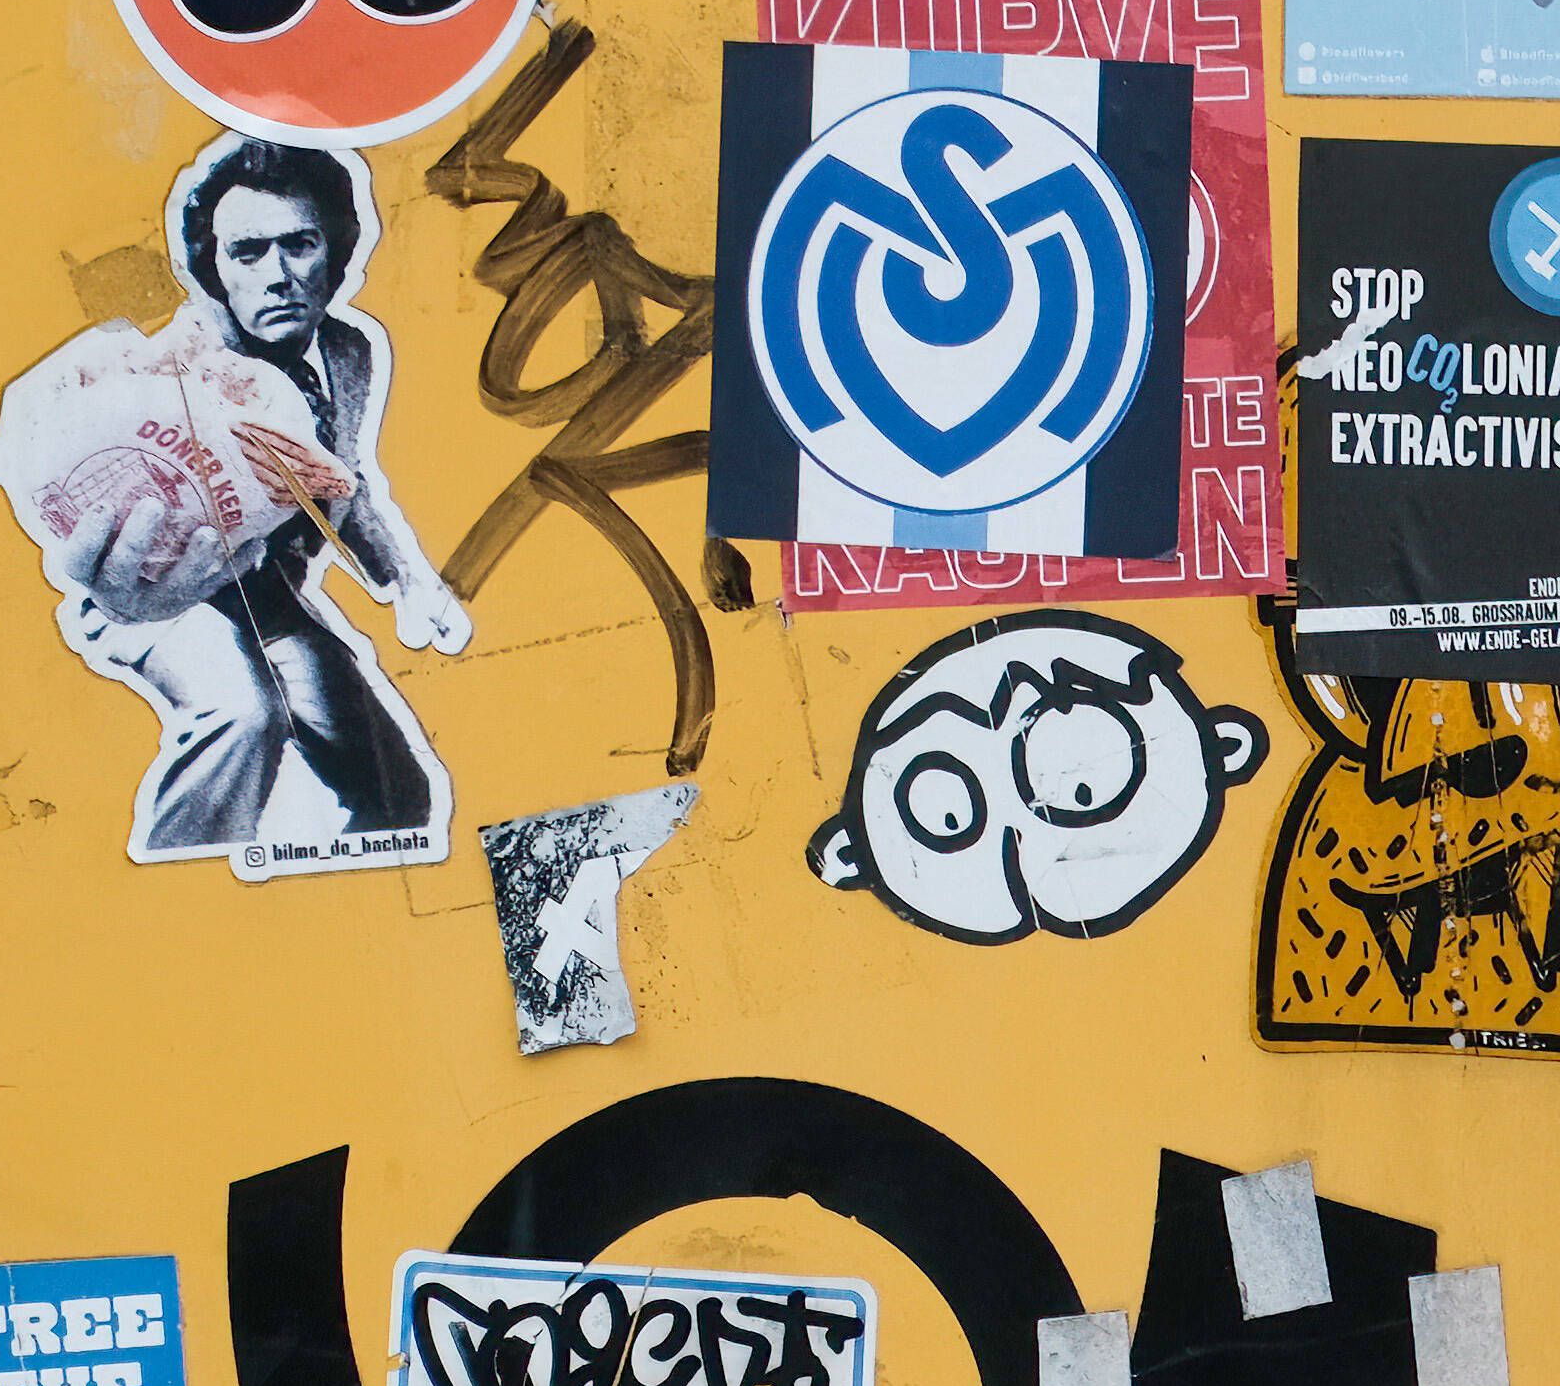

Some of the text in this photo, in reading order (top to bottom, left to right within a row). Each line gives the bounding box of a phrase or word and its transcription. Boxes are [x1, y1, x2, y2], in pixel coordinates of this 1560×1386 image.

[1331, 267, 1425, 320] STOP
[1390, 606, 1466, 627] 09.-15.08.
[1472, 602, 1558, 623] GROSSRAUM
